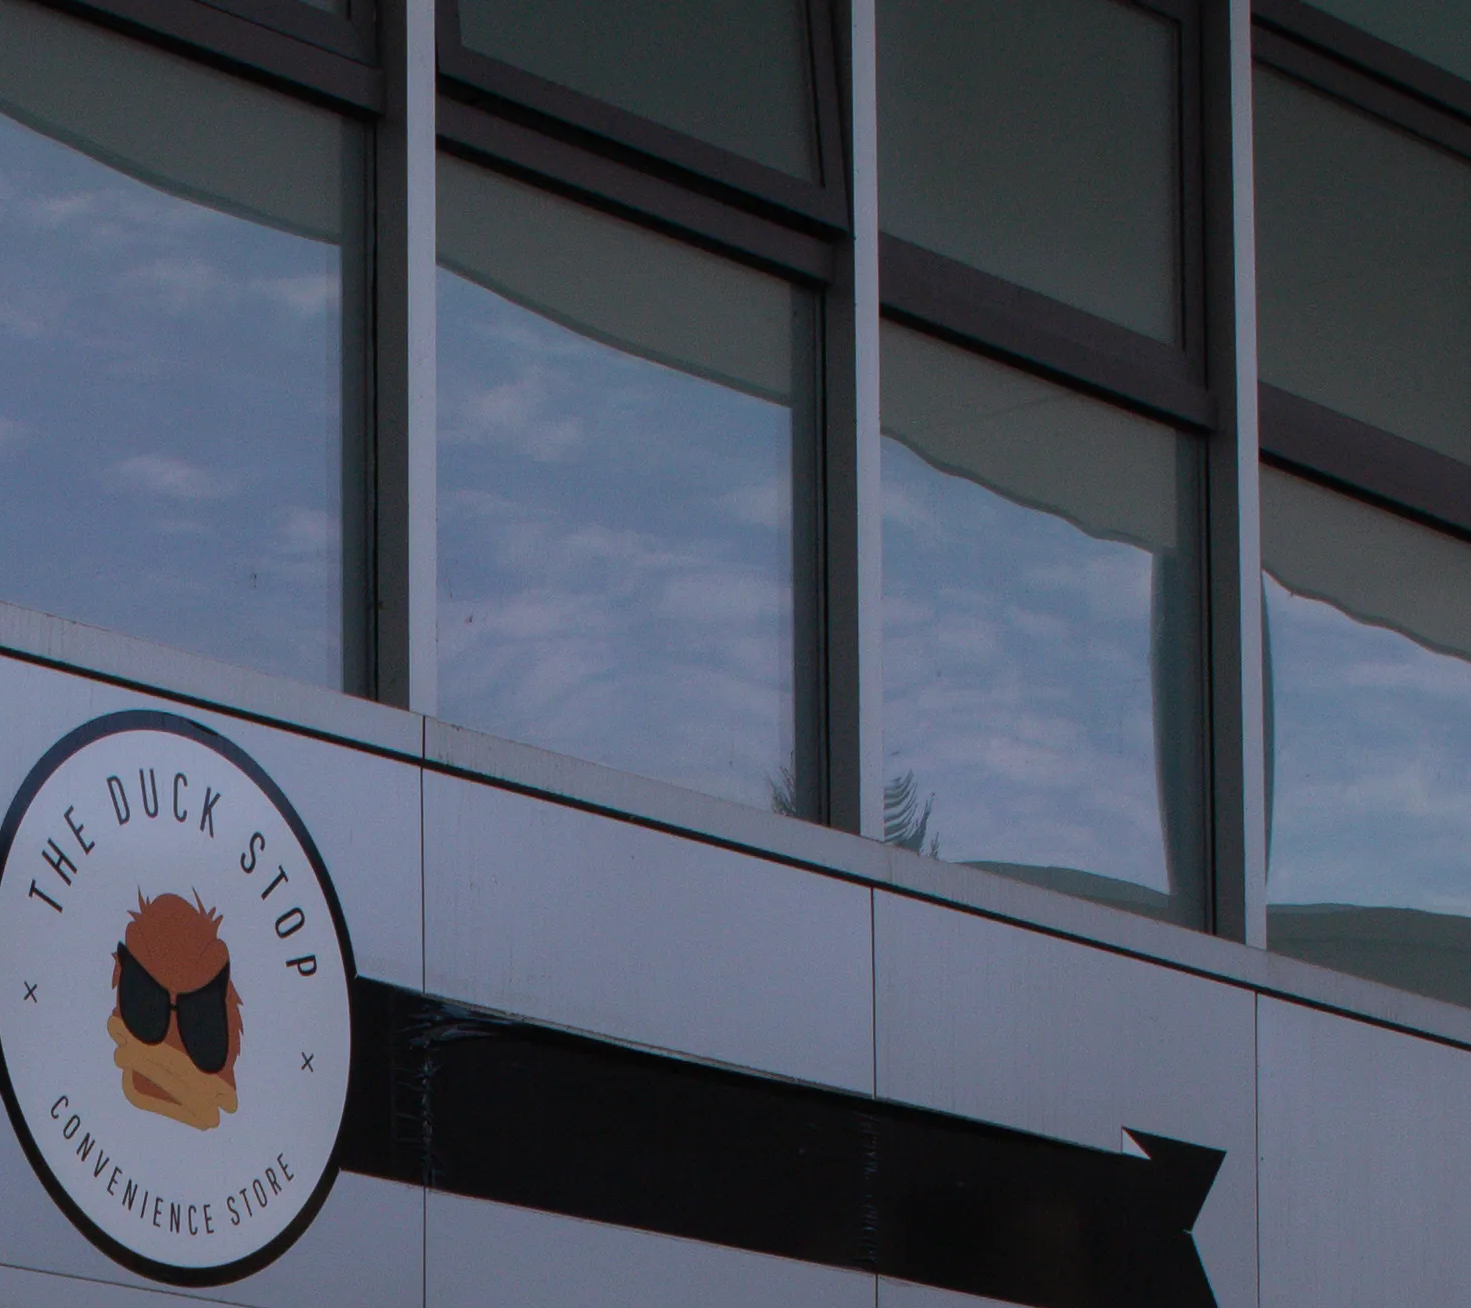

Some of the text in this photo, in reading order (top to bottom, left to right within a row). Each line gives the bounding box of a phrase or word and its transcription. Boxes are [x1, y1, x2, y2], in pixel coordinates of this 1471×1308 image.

[28, 768, 317, 976] THE DUCK STOP
[50, 1095, 295, 1236] CONVENIENCE STORE
